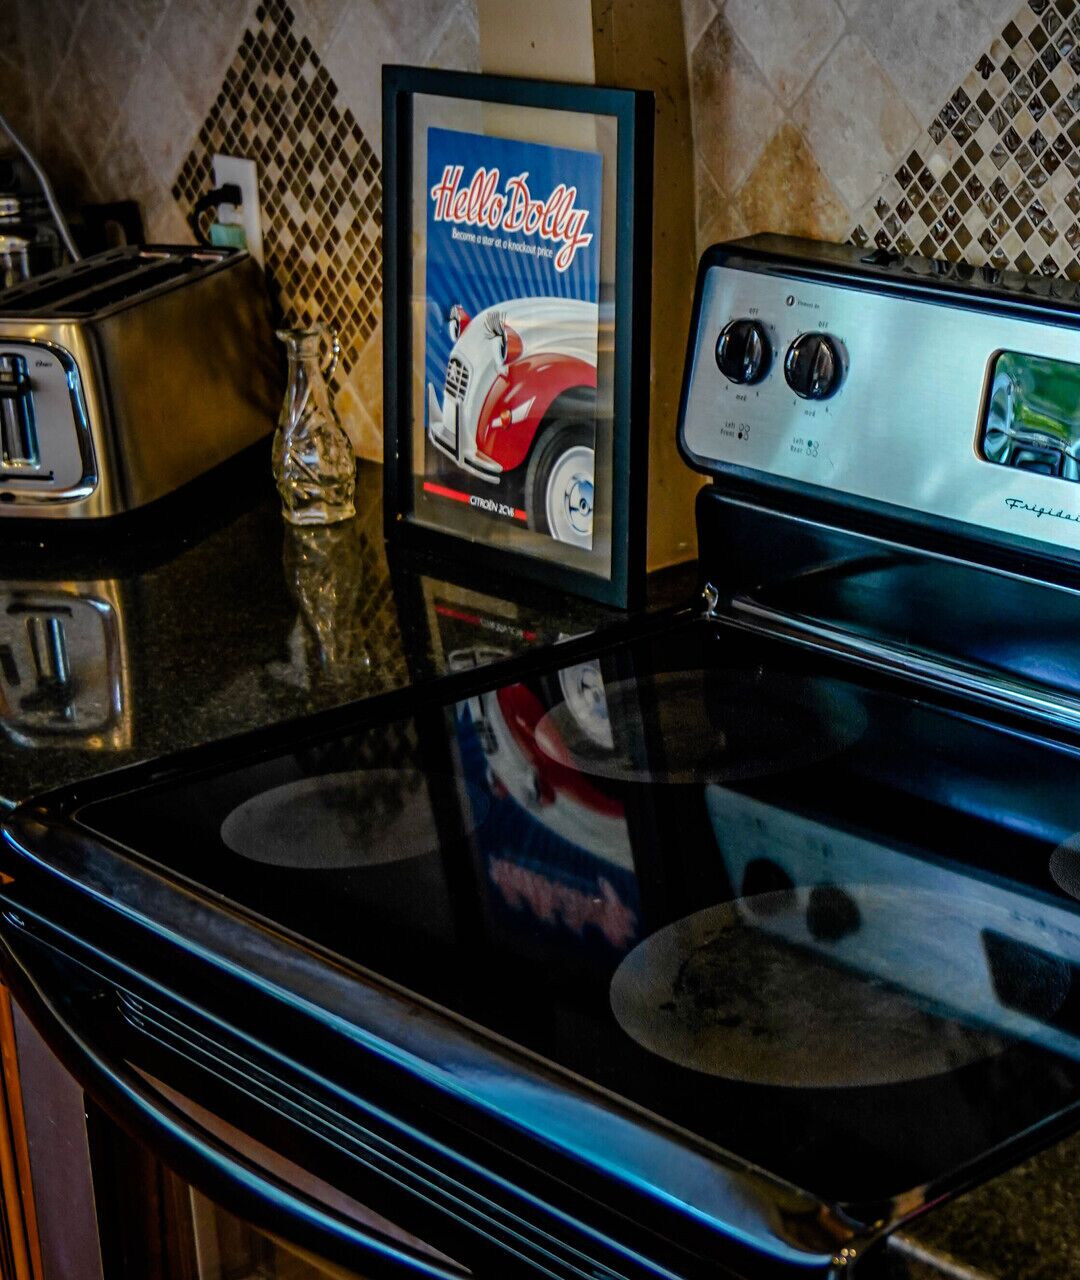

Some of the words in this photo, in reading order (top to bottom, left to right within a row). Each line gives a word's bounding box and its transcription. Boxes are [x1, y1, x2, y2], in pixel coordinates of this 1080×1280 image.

[431, 165, 508, 230] Hello
[502, 172, 593, 273] Dolly
[451, 227, 476, 242] Become
[477, 235, 482, 243] a
[482, 236, 494, 246] star
[495, 239, 502, 248] at
[502, 240, 508, 249] a
[508, 239, 537, 254] knockout
[537, 247, 553, 258] price
